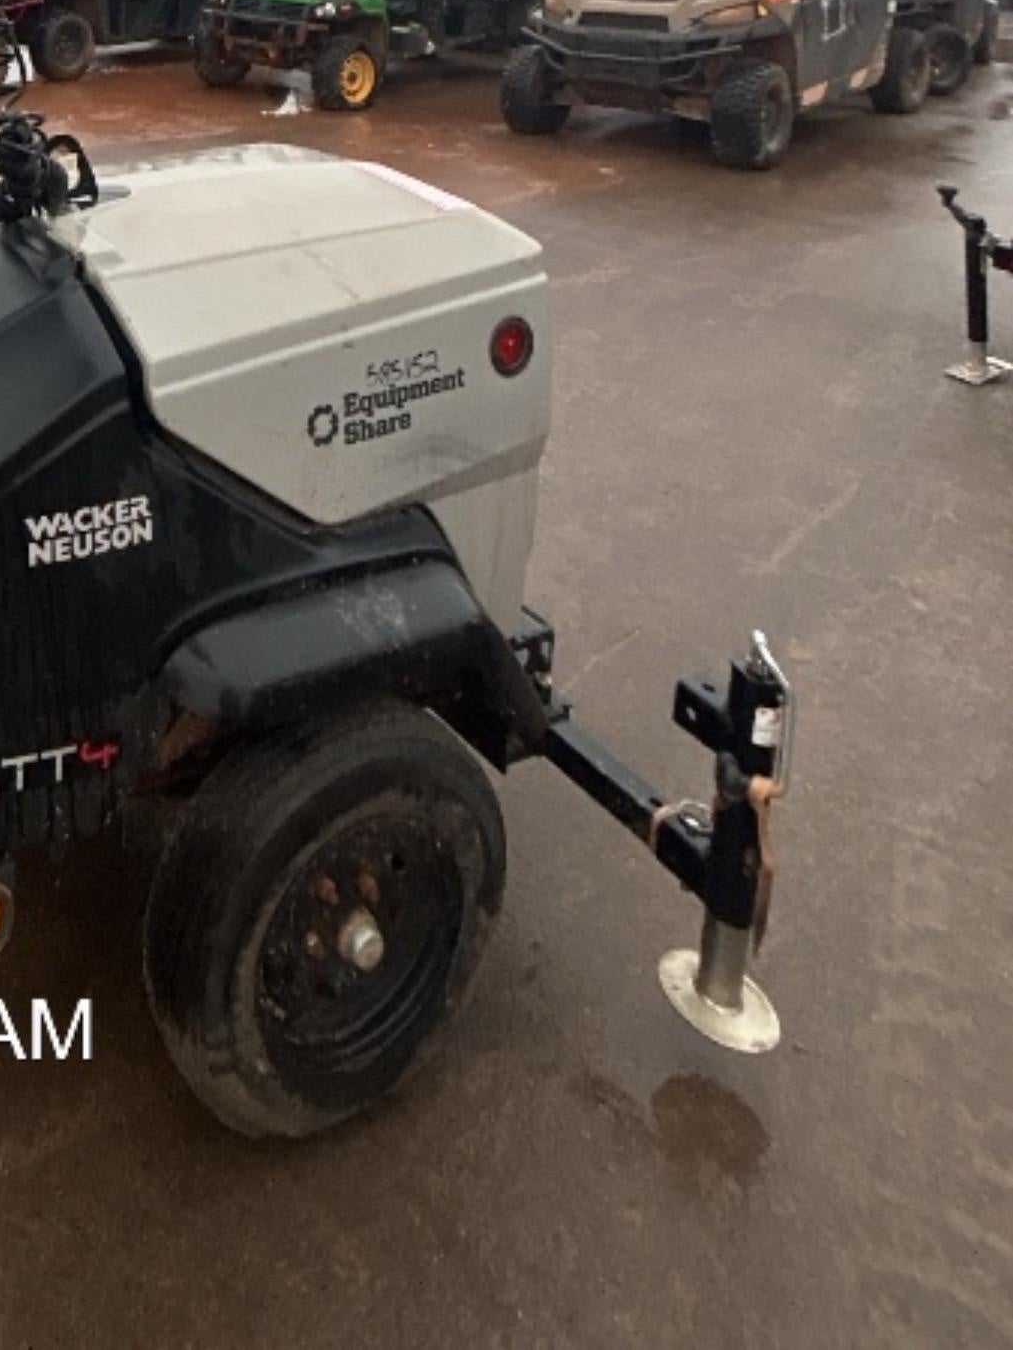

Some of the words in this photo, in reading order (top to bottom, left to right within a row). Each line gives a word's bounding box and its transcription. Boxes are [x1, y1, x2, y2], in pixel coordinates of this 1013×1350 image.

[343, 366, 465, 417] Equipment
[343, 412, 411, 445] Share
[24, 494, 152, 541] WACKER
[27, 518, 154, 569] NEUSON
